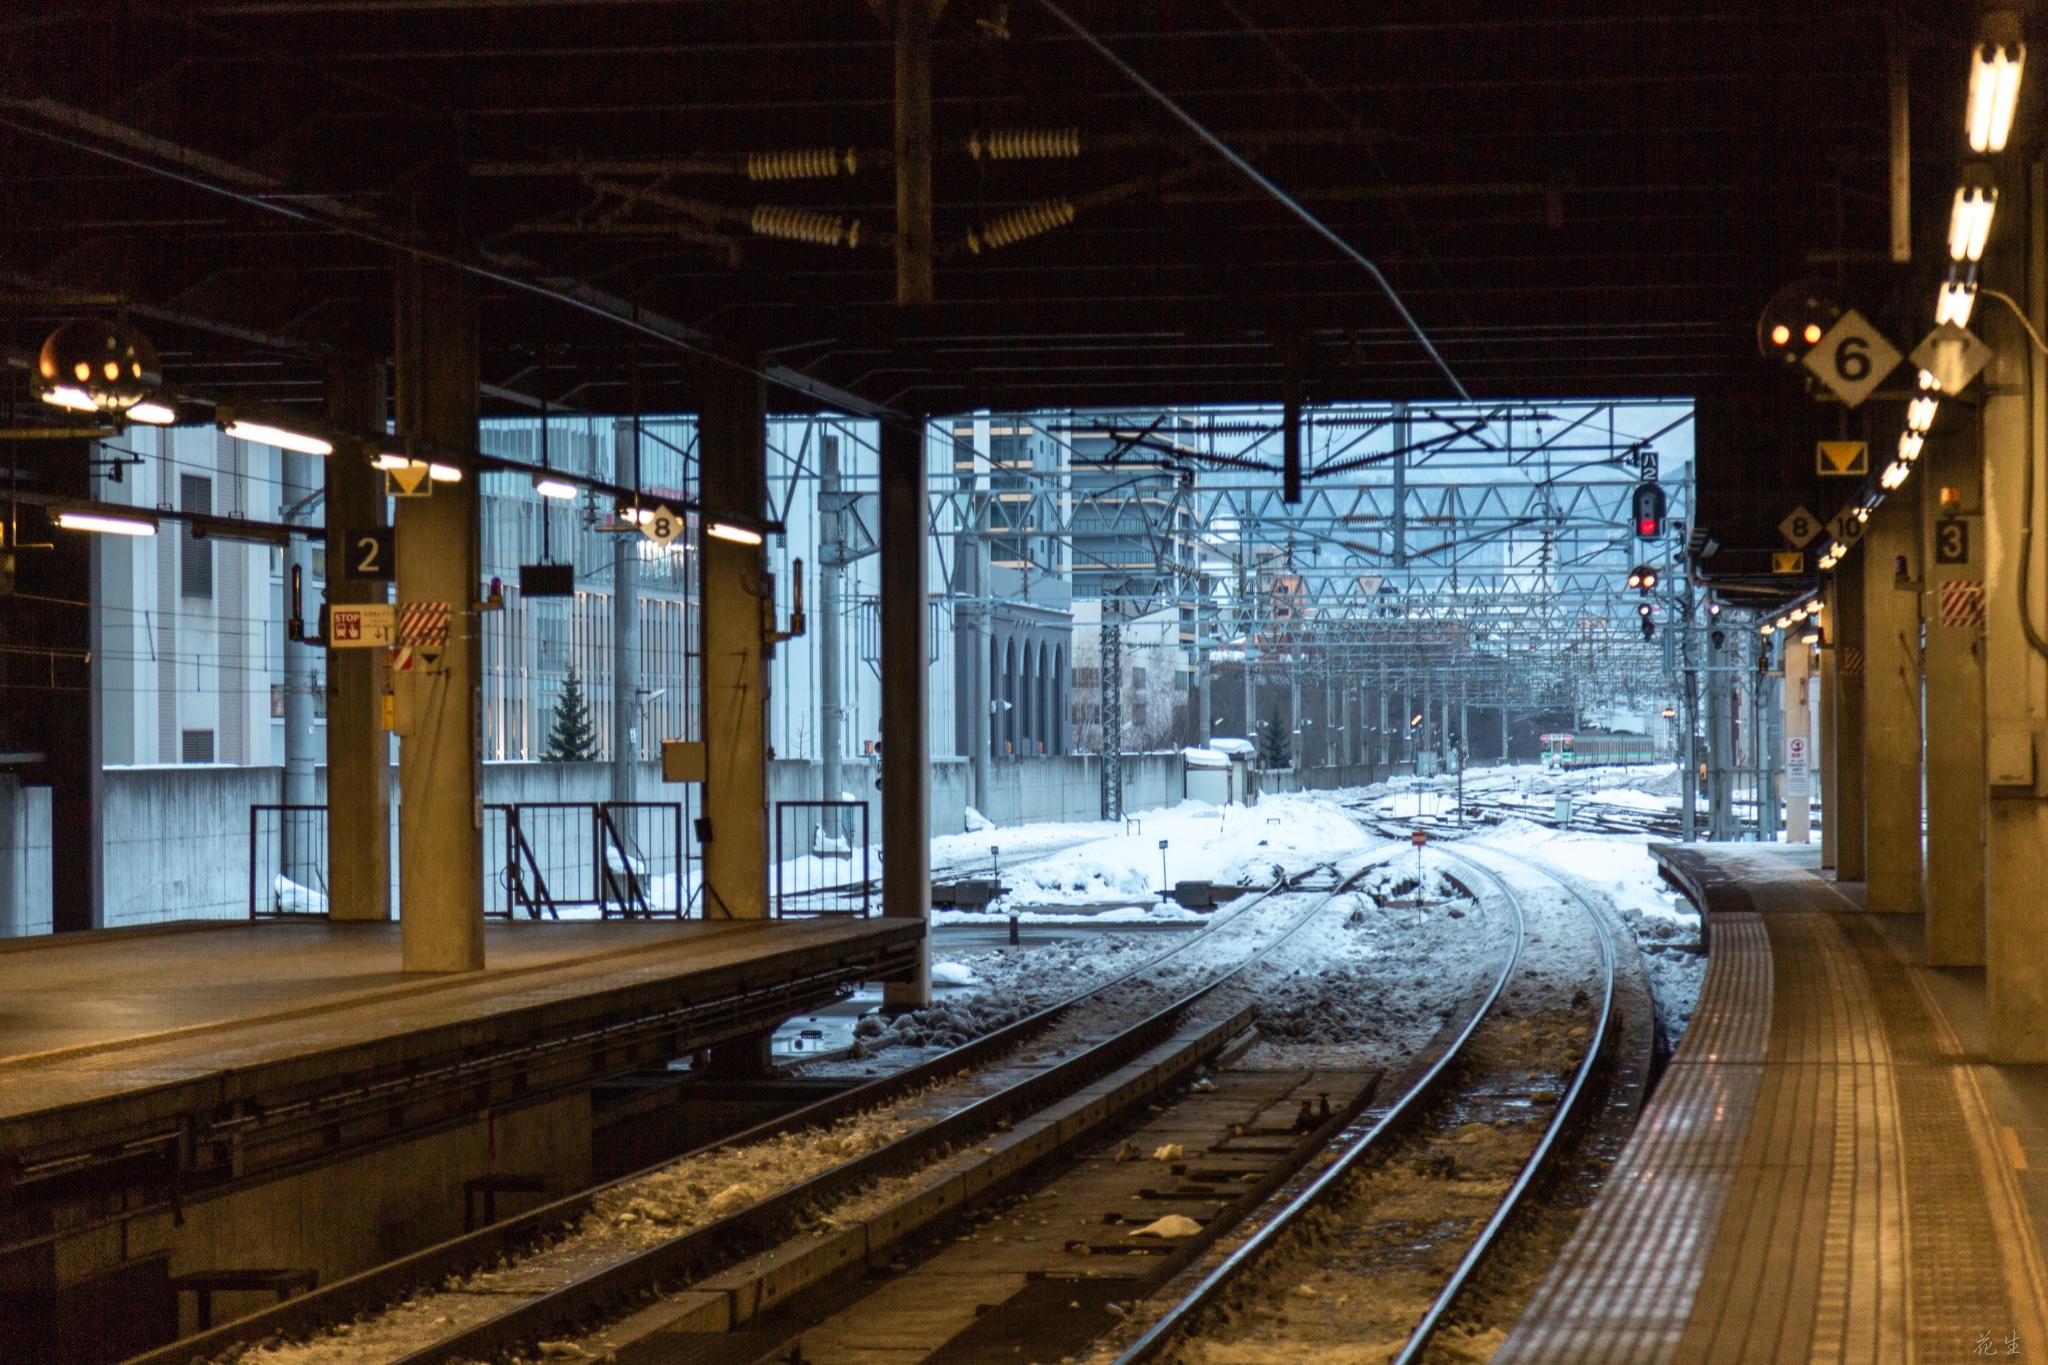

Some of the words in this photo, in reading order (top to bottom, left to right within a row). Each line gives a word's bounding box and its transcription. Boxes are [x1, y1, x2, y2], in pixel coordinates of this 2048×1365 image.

[1834, 337, 1872, 381] 6
[654, 517, 671, 538] 8
[1792, 517, 1809, 538] 8
[1838, 517, 1860, 538] 10
[1942, 525, 1963, 558] 3
[358, 537, 379, 571] 2
[335, 613, 360, 623] STOP
